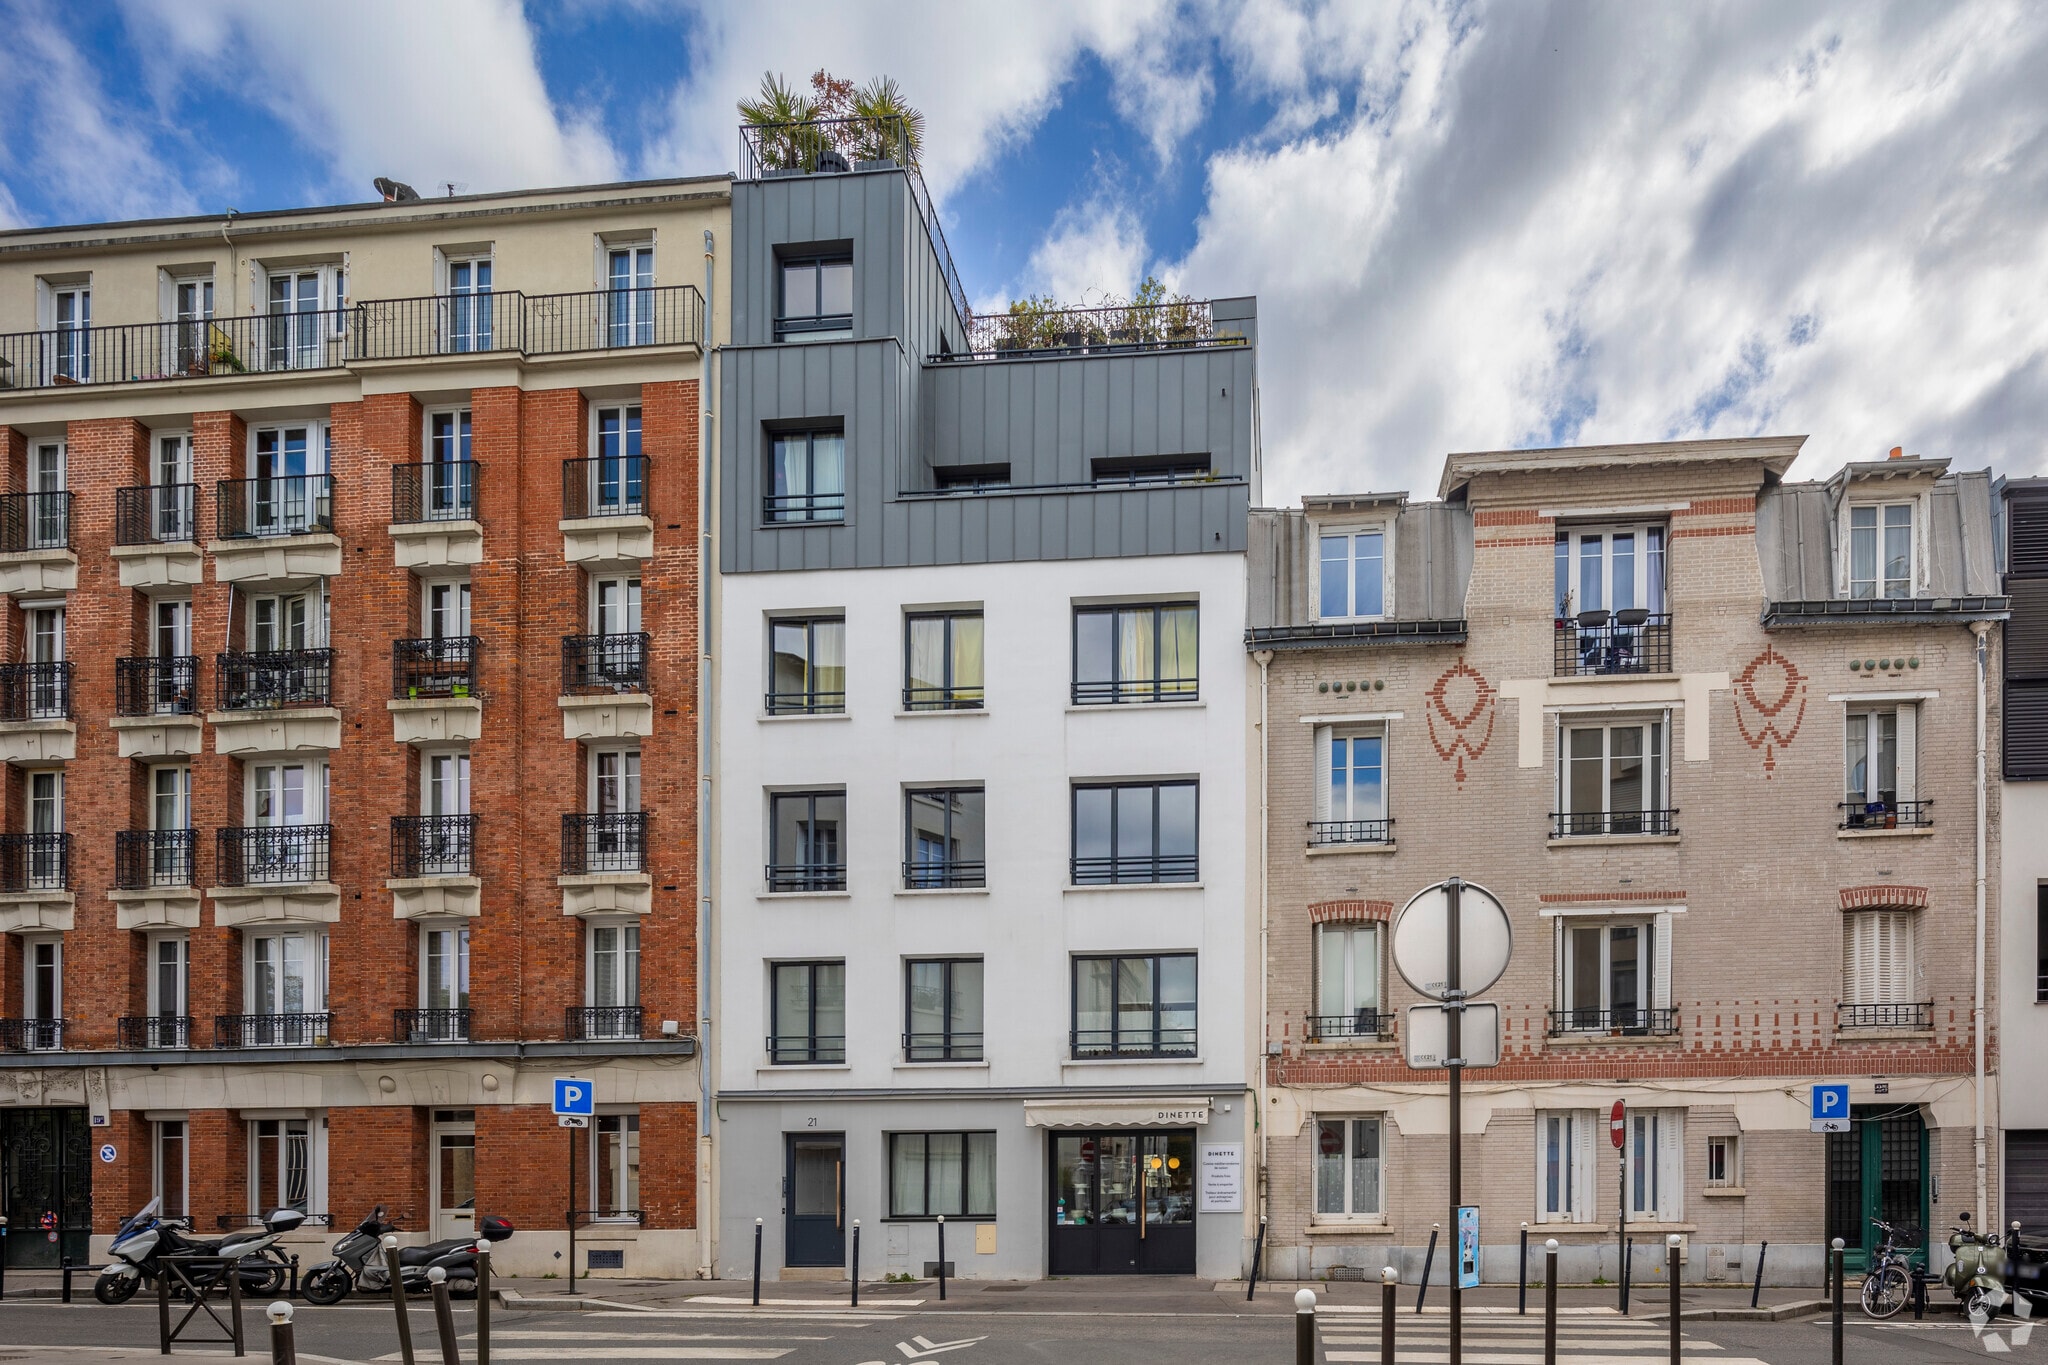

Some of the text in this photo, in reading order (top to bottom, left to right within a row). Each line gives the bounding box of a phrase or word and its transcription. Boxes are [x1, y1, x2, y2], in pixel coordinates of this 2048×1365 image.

[564, 1085, 583, 1108] P
[1822, 1091, 1839, 1113] P
[807, 1117, 817, 1127] 21
[1158, 1111, 1204, 1119] DINETTE
